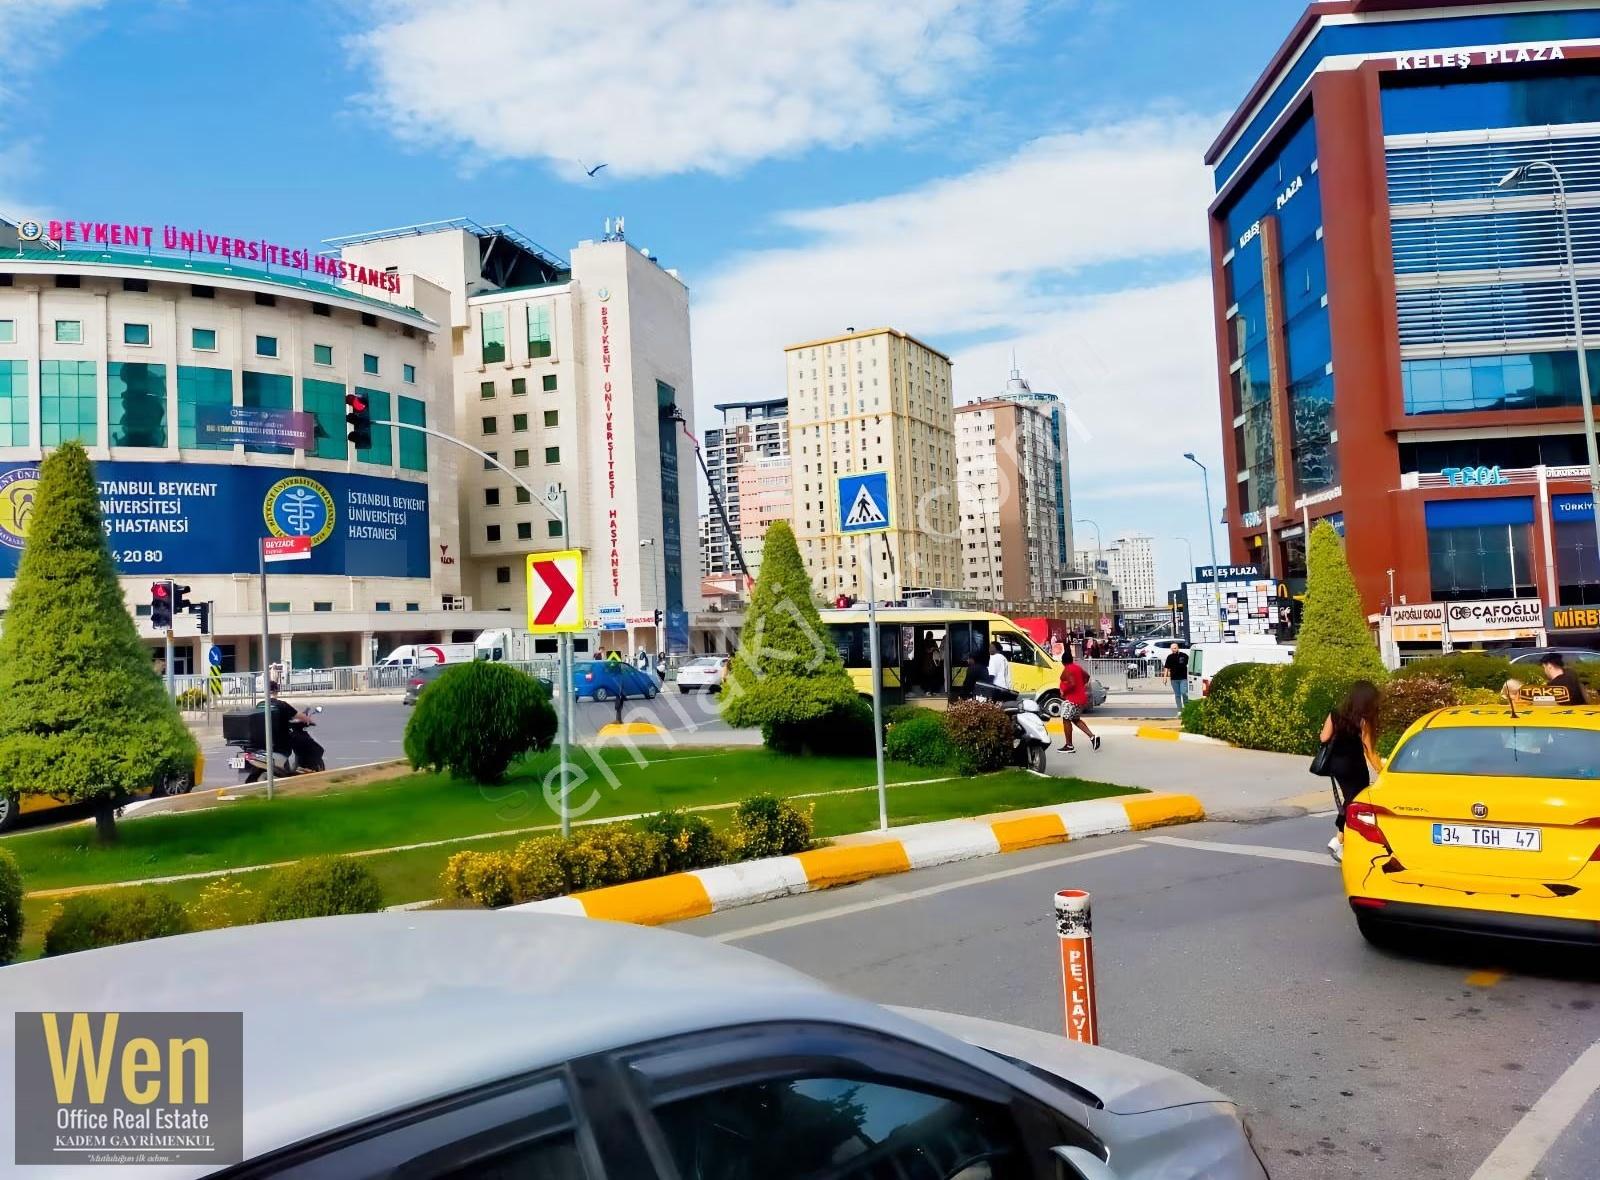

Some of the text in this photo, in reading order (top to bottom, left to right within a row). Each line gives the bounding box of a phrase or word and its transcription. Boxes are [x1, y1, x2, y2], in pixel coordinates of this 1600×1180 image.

[1396, 46, 1565, 69] KELEŞ PLAZA
[49, 219, 400, 295] BEYKENT ÜNİVERSİTESİ HASTANESİ
[96, 481, 217, 497] STANBUL BEYKENT
[100, 497, 180, 514] NİVERSİTESİ
[348, 489, 425, 512] İSTANBUL BEYKENT
[1560, 501, 1593, 511] TÜRKİY
[115, 516, 188, 533] HASTANESİ
[348, 506, 407, 526] ÜNİVERSİTESİ
[348, 525, 397, 541] HASTANESİ
[124, 550, 142, 563] 20
[144, 550, 163, 563] 80
[1202, 567, 1258, 578] KEEŞ PLAZA
[1423, 608, 1441, 619] GOLD
[1472, 601, 1540, 620] ÇAFOĞLU
[1553, 607, 1600, 628] MİRB
[1485, 615, 1540, 624] KUYUMCULUK
[1443, 827, 1535, 848] 34 TGH 47
